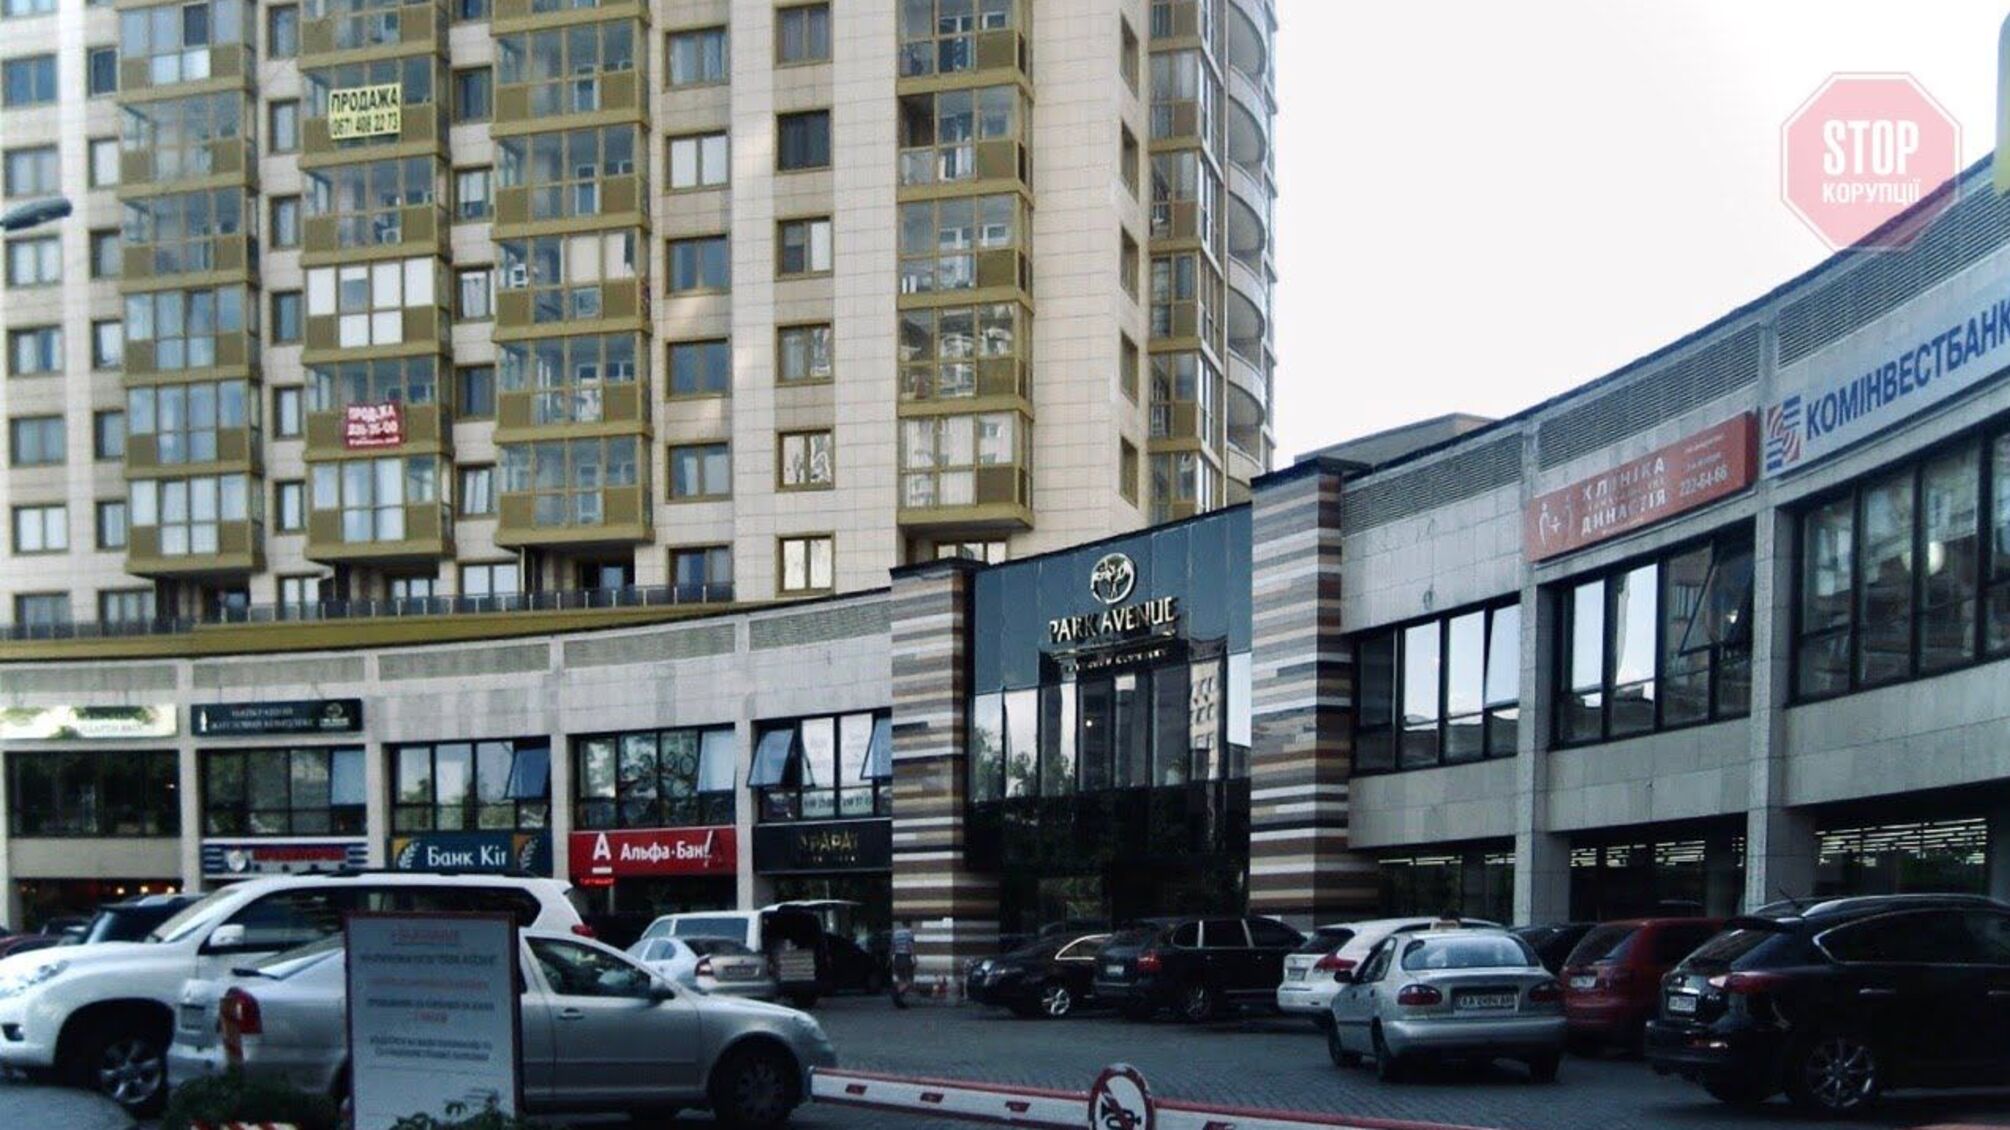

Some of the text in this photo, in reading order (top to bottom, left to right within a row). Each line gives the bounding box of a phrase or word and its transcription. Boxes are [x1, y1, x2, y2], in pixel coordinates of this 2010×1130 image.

[332, 86, 399, 113] ПРОДАЖА
[1806, 299, 2010, 441] КОМІНВЕСТБАНК
[1582, 457, 1665, 500] КЛІНІКА
[1048, 597, 1176, 643] PARK AVENUE
[428, 845, 474, 867] Банк
